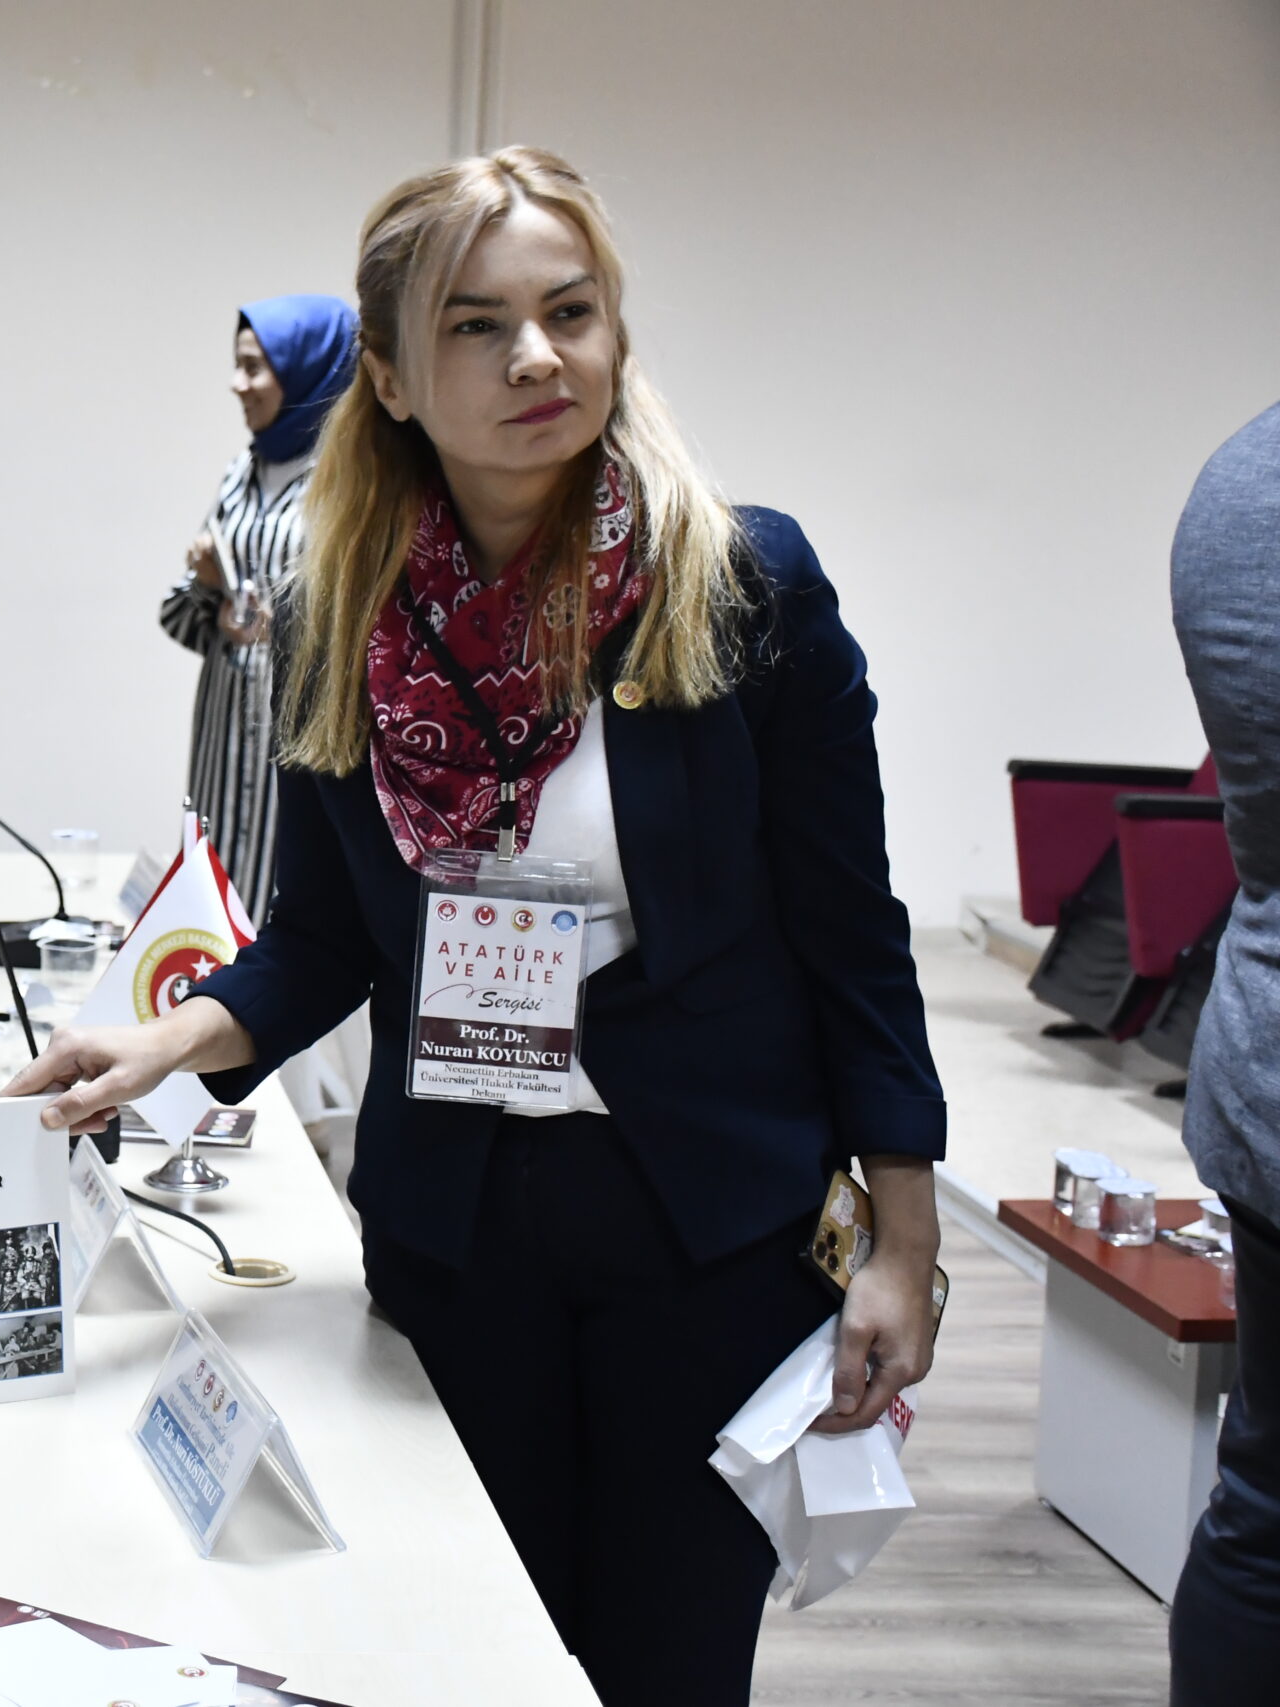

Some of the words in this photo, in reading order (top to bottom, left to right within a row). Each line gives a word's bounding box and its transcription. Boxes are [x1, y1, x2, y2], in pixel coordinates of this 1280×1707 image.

[438, 941, 563, 965] ATATÜRK
[446, 961, 474, 977] VE
[494, 965, 553, 984] AİLE
[478, 992, 543, 1015] Sergisi
[460, 1024, 499, 1041] Prof.
[504, 1029, 530, 1044] Dr.
[420, 1041, 473, 1058] Nuran
[477, 1046, 567, 1067] KOYUNCU
[420, 1071, 478, 1086] Üniversitesi
[481, 1079, 516, 1089] Hukuk
[517, 1081, 561, 1093] Fakültesi
[444, 1064, 495, 1076] Necmettin
[498, 1069, 539, 1080] Erbakan
[151, 1404, 166, 1433] Prof.
[163, 1423, 173, 1444] Dr.
[184, 1453, 221, 1506] KÖSTÜKLÜ
